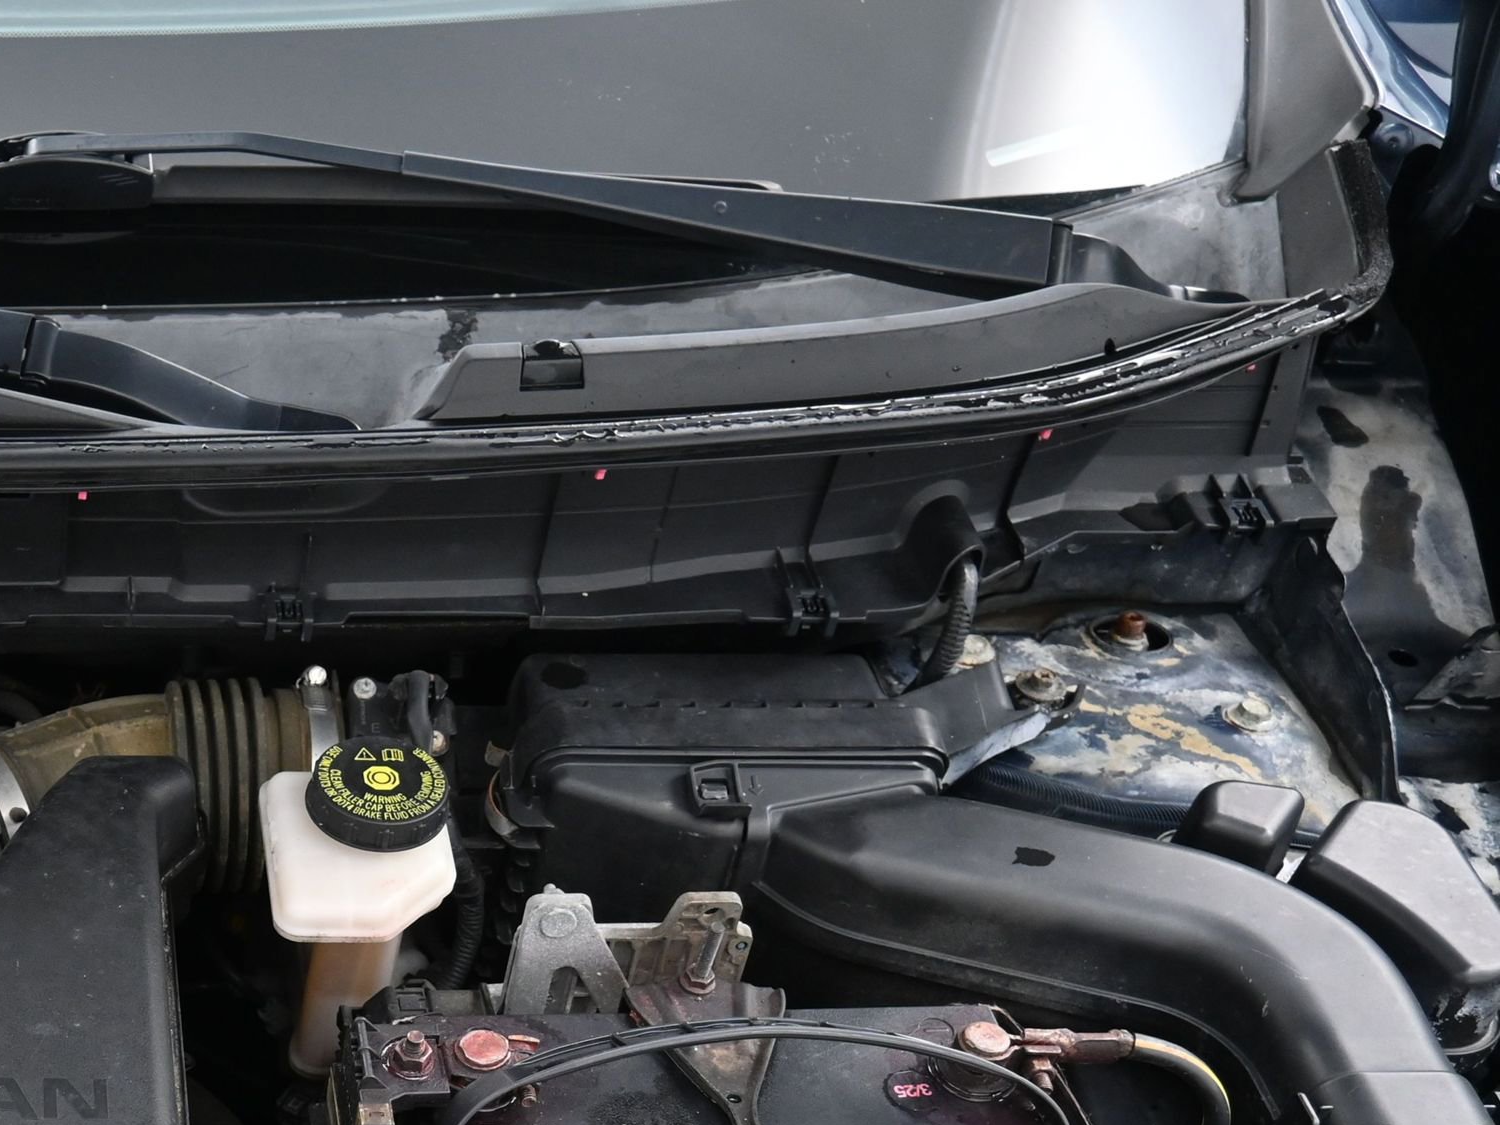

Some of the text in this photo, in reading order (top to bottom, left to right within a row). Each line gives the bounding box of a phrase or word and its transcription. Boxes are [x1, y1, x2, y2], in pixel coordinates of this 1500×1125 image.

[326, 745, 343, 759] USE
[412, 747, 445, 779] CONTAINER
[323, 787, 338, 798] OR
[330, 769, 433, 812] CLEAN FILLER CAP BEFORE REMOVING
[429, 779, 446, 801] SEALED
[332, 795, 355, 811] DOT4
[363, 792, 407, 804] WARNING
[426, 799, 438, 807] A
[352, 806, 382, 820] BRAKE
[383, 810, 409, 820] FLUID
[407, 802, 433, 817] FROM
[893, 1083, 933, 1098] 3/25
